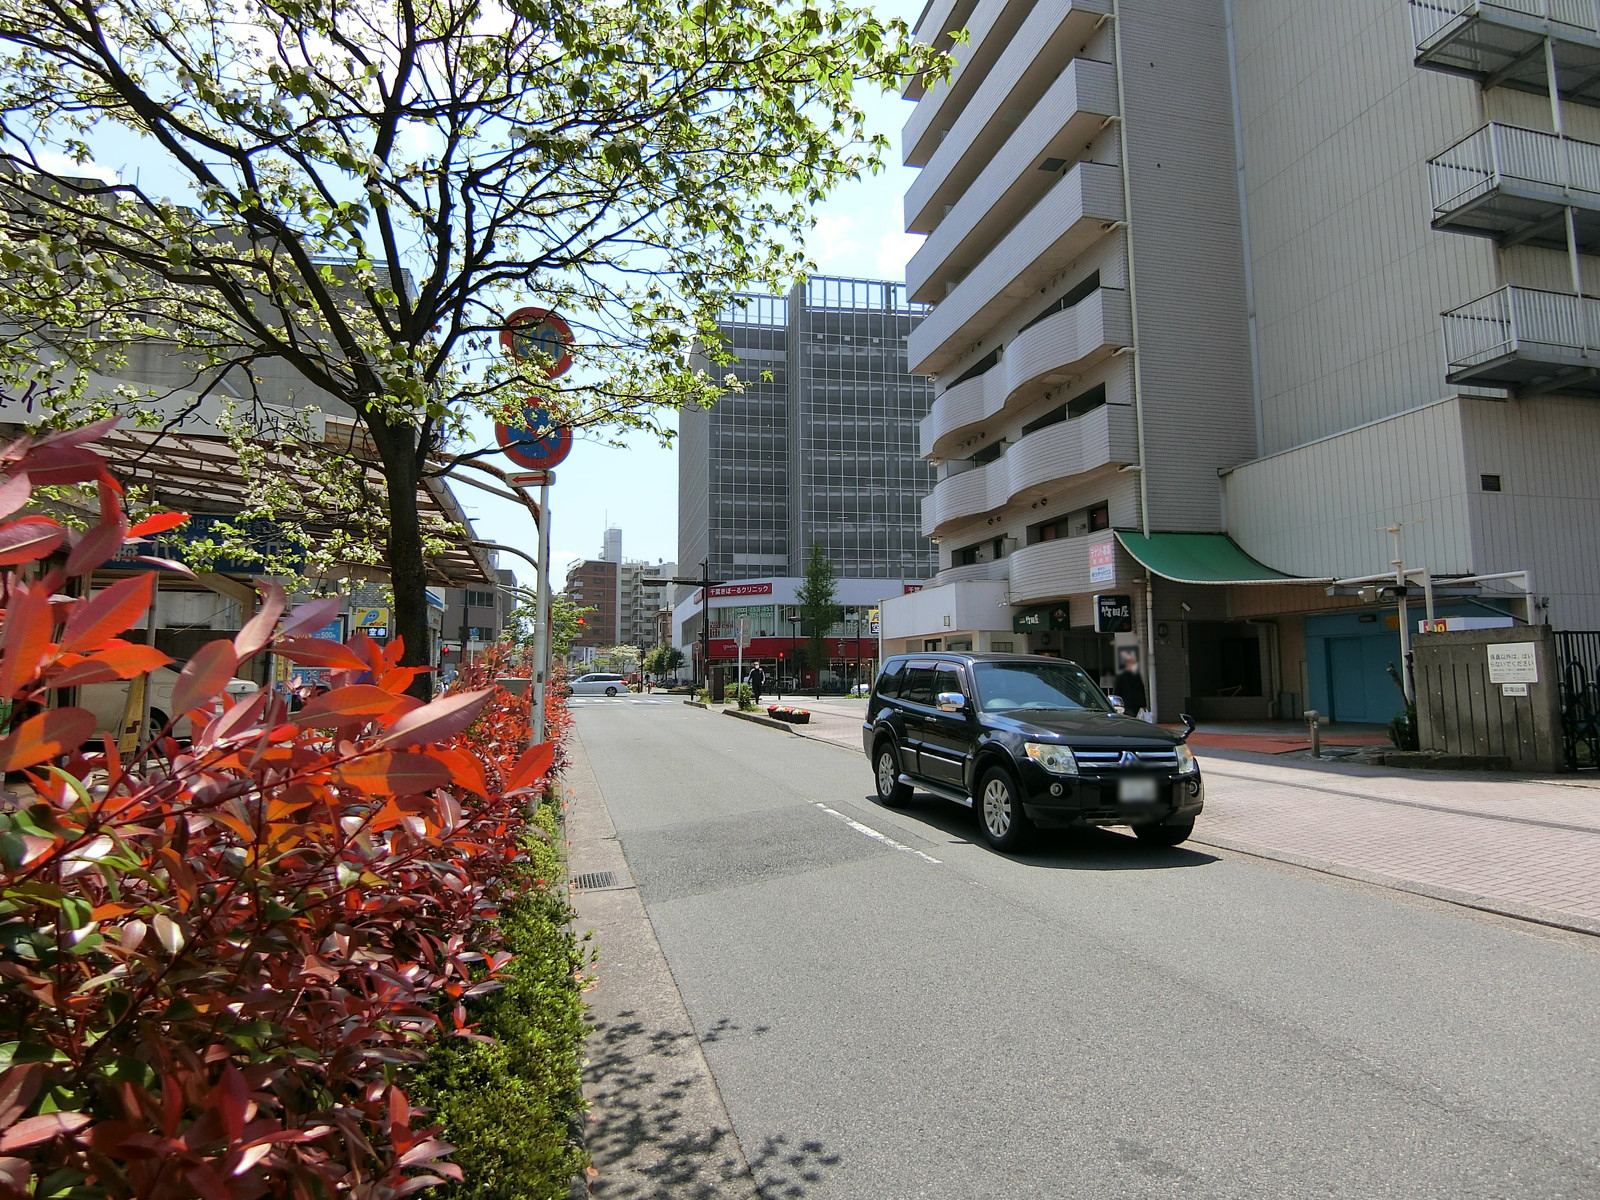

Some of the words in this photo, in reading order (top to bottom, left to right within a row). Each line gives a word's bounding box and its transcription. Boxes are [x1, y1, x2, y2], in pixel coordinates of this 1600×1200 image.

[709, 585, 769, 596] 千葉きぼーるクリニック
[1101, 605, 1130, 618] 竹田屋
[368, 627, 386, 636] 空車
